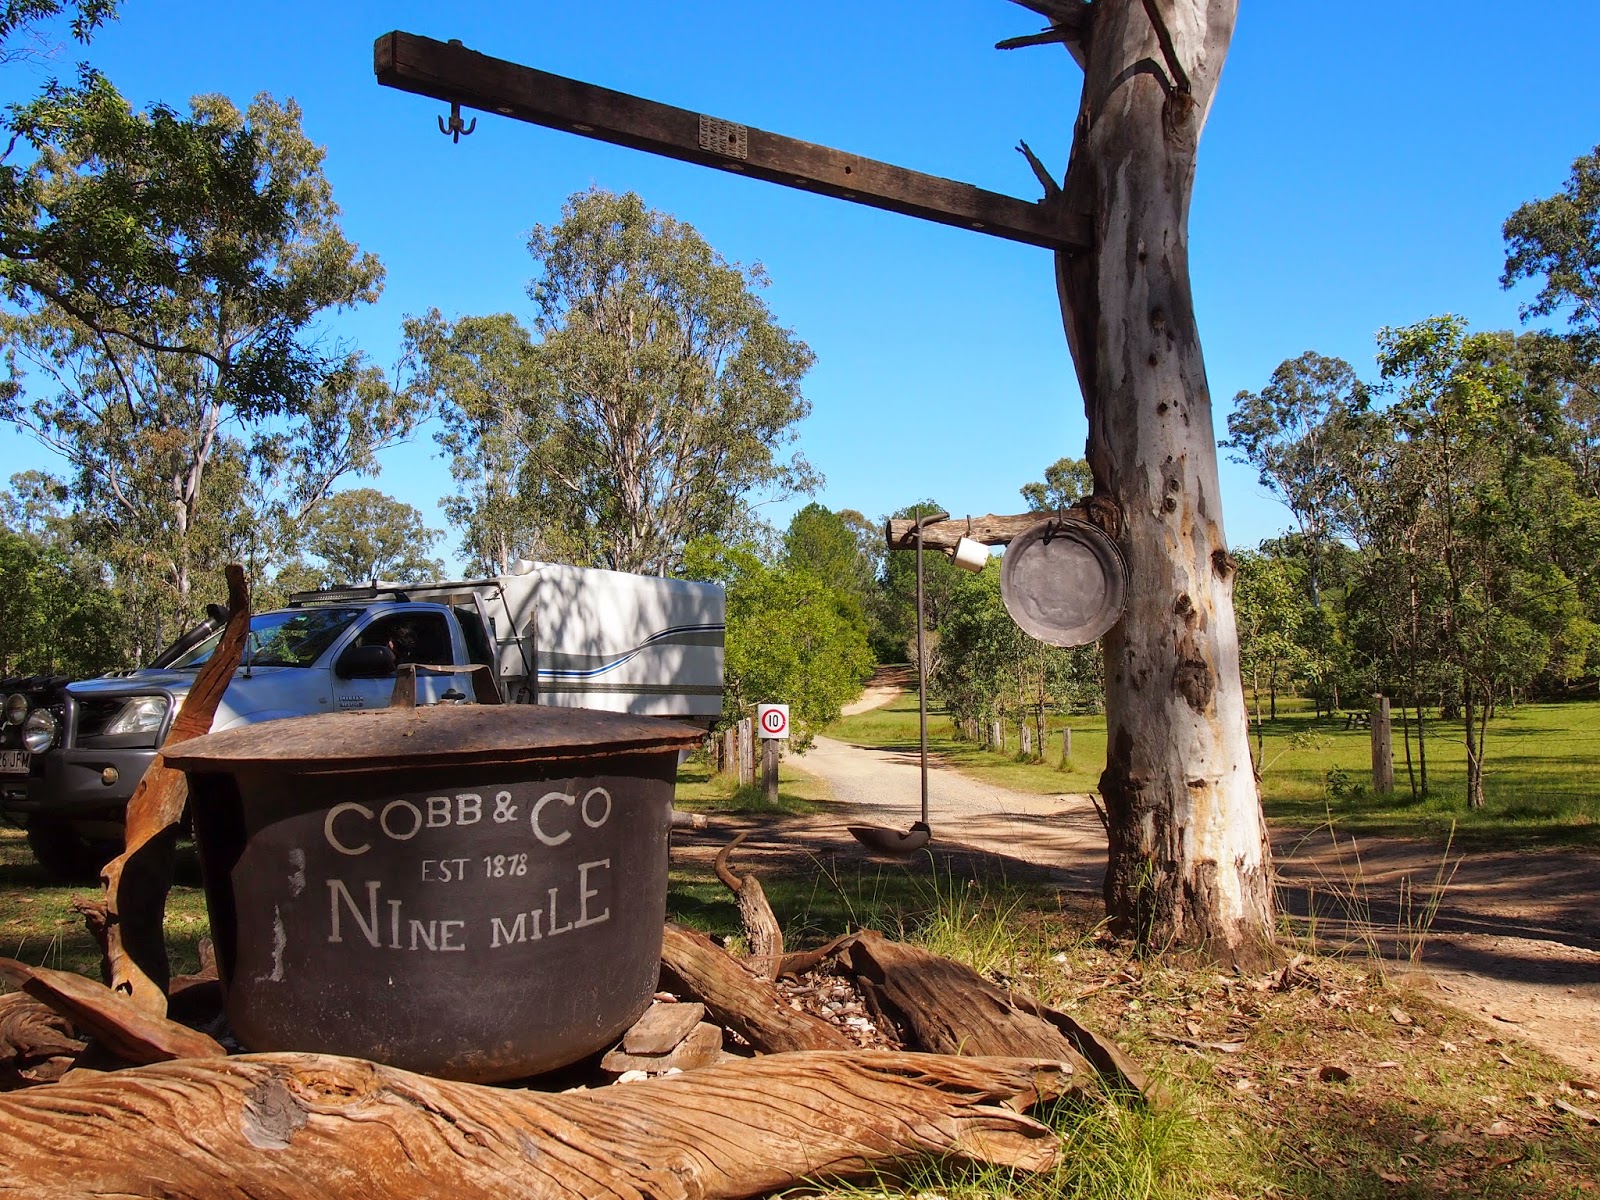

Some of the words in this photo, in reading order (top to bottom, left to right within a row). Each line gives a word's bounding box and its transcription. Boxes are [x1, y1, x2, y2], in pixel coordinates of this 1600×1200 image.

[769, 714, 779, 727] 10
[10, 752, 30, 768] JFM
[324, 793, 482, 855] COBB
[493, 791, 518, 823] &
[531, 787, 612, 846] CO
[421, 858, 471, 883] EST
[483, 853, 528, 878] 1878
[326, 879, 466, 951] NINE
[490, 858, 611, 948] MILE
